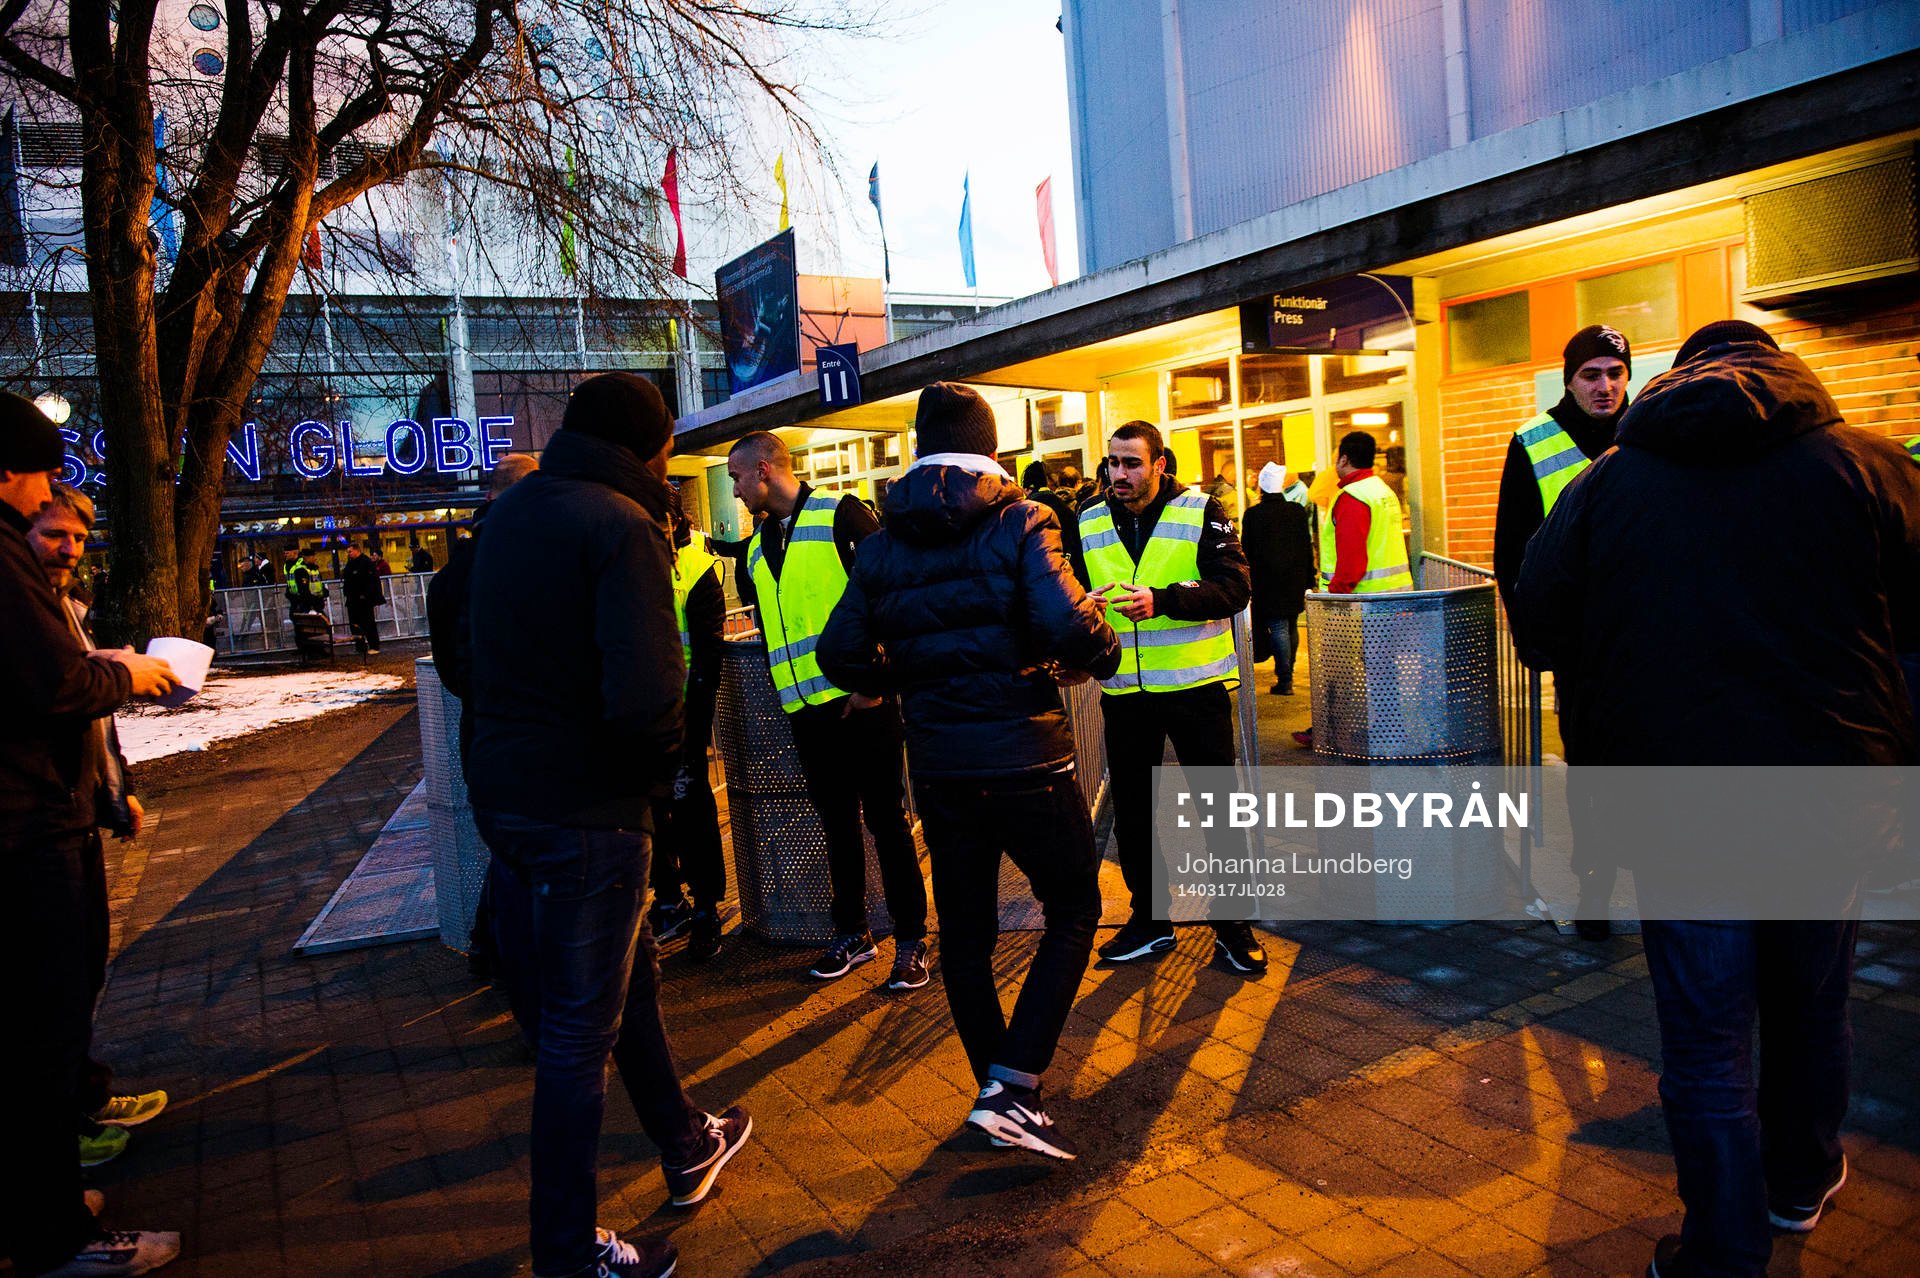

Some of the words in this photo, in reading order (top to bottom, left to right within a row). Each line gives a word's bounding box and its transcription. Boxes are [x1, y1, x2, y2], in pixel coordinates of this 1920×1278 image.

[1273, 295, 1328, 309] Funktionär
[1274, 310, 1304, 325] Press
[822, 360, 841, 369] Entré
[290, 415, 515, 479] GLOBE
